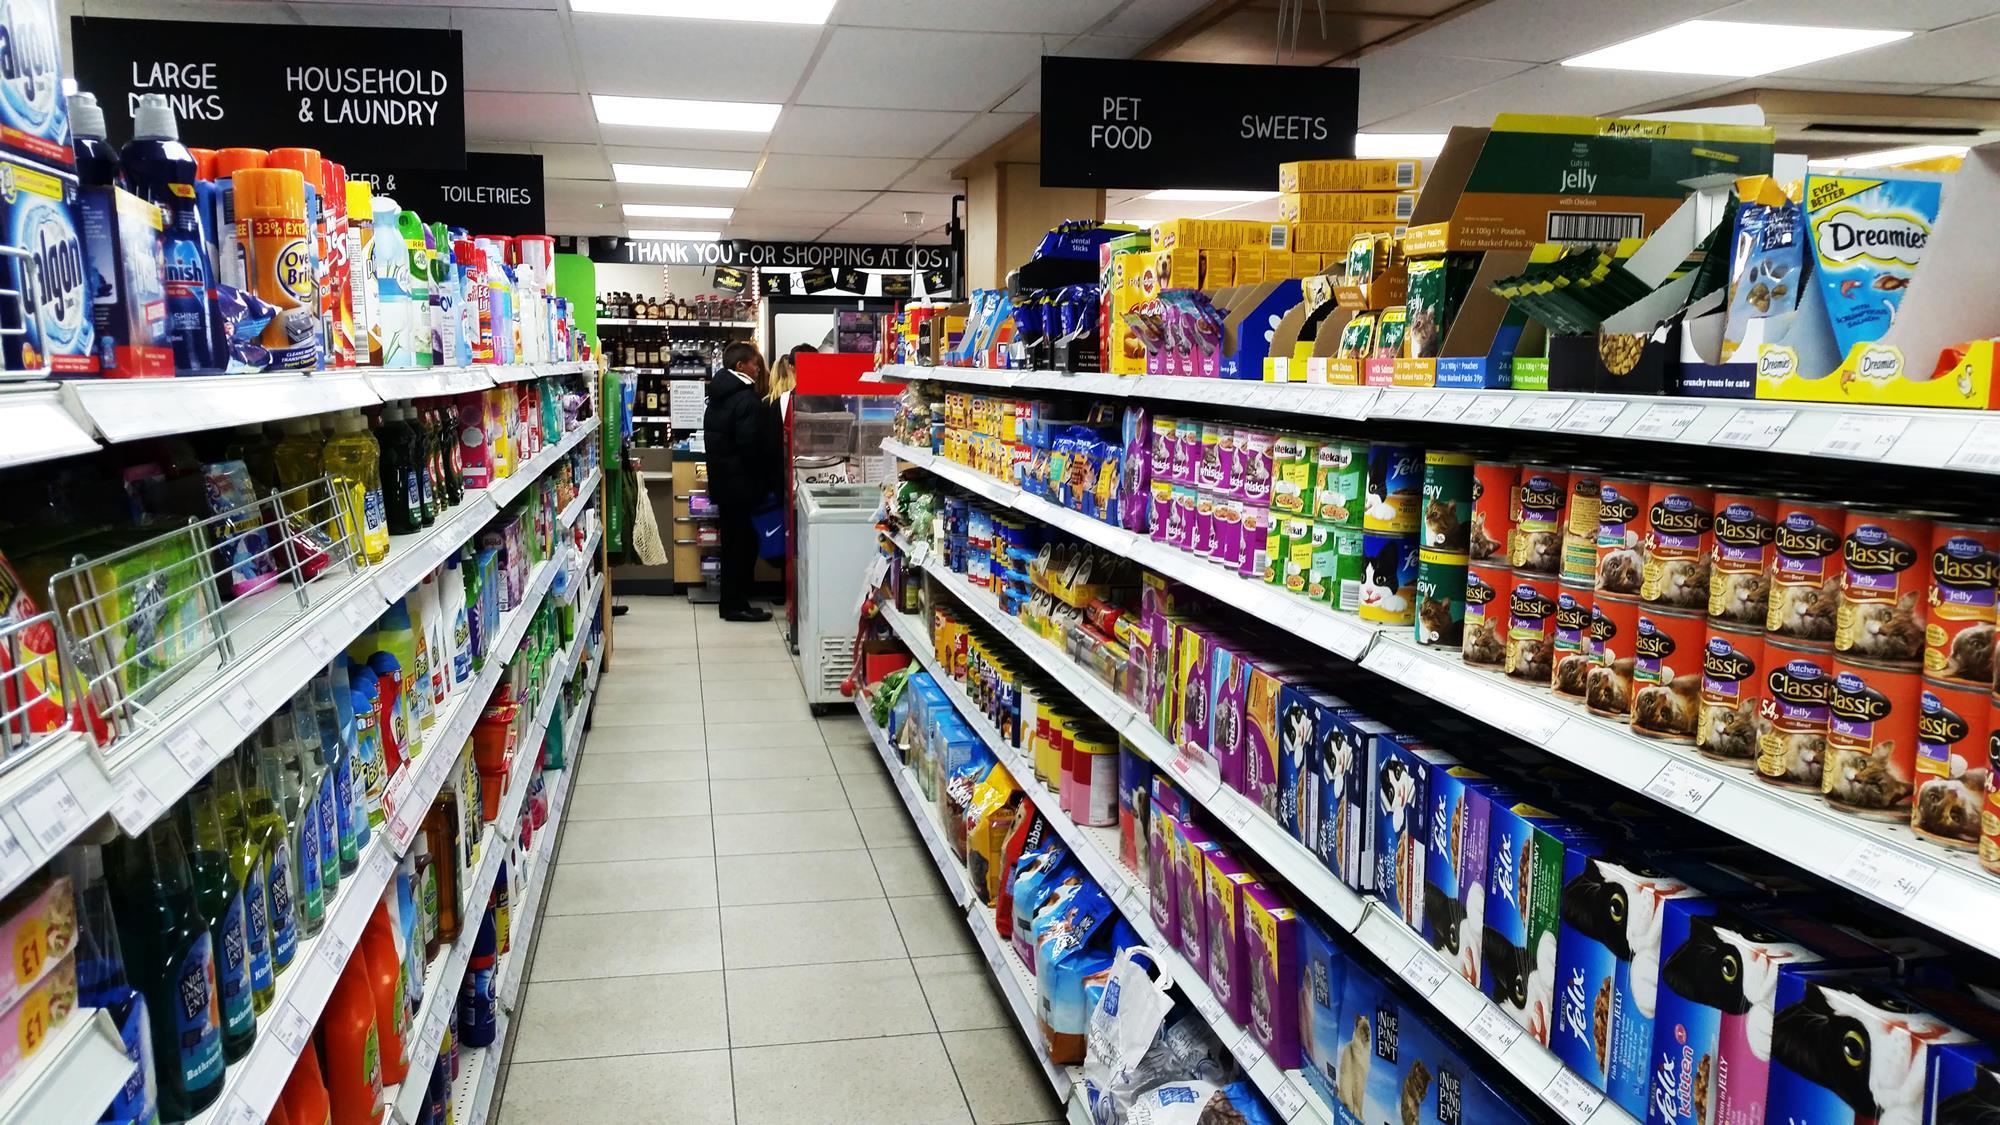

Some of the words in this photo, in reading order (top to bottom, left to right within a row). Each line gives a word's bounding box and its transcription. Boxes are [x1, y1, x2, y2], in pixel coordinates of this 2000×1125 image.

[132, 61, 218, 89] LARGE
[286, 66, 448, 96] HOUSEHOLD
[128, 92, 224, 120] DNKS
[298, 97, 314, 122] &
[324, 98, 439, 126] LAUNDRY
[1102, 96, 1141, 121] PET
[1090, 124, 1153, 150] FOOD
[1240, 115, 1328, 141] SWEETS
[1607, 121, 1631, 135] Any
[1570, 159, 1582, 168] Cuts
[386, 174, 396, 191] &
[1560, 169, 1598, 193] Jelly
[1812, 181, 1839, 198] EVEN
[441, 185, 532, 205] TOILETRIES
[1559, 198, 1573, 206] with
[1574, 199, 1597, 207] Chicken
[1811, 188, 1846, 210] BETTER
[256, 222, 282, 235] 33%
[1500, 227, 1526, 236] Pouches
[1828, 222, 1928, 252] Dreamies
[1460, 239, 1476, 247] Price
[1478, 239, 1503, 248] Marked
[1505, 240, 1523, 248] Packs
[285, 252, 310, 267] Ove
[625, 241, 688, 264] THANK
[693, 241, 733, 264] YOU
[783, 246, 874, 267] SHOPPING
[880, 248, 901, 267] AT
[166, 257, 202, 282] nish
[1461, 362, 1478, 370] Pouches
[1762, 353, 1791, 372] Dreamies
[1863, 353, 1896, 372] Dreamies
[1707, 378, 1724, 389] treats
[1725, 378, 1735, 388] for
[1736, 378, 1750, 388] cats
[1520, 487, 1566, 506] Classic
[1663, 496, 1692, 509] Butcher's
[1600, 502, 1633, 519] assic
[1650, 506, 1710, 531] Classic
[1726, 506, 1755, 519] Butcher's
[1786, 514, 1815, 527] Butcher's
[1714, 517, 1774, 541] Classic
[1775, 526, 1833, 551] Classic
[1856, 527, 1888, 540] Butcher's
[1664, 535, 1683, 546] Jelly
[1948, 541, 1984, 553] Butcher's
[1727, 548, 1745, 560] Jelly
[1843, 539, 1909, 566] Classic
[1786, 559, 1804, 570] Jelly
[1933, 552, 2000, 581] Classic
[1857, 574, 1877, 587] Jelly
[1466, 586, 1491, 600] assic
[1950, 590, 1972, 604] Jelly
[1510, 595, 1551, 615] Classic
[1557, 606, 1590, 627] lassic
[1636, 635, 1669, 655] assic
[1788, 663, 1822, 675] Butcher's
[1769, 672, 1831, 699] Classi
[1836, 677, 1864, 690] Butcher's
[1788, 705, 1811, 718] Jelly
[1836, 721, 1854, 733] Jelly
[1919, 714, 1960, 739] assic
[1434, 794, 1450, 865] felix
[1498, 833, 1516, 910] felix
[1226, 887, 1233, 903] £1
[1267, 924, 1275, 943] £1
[22, 940, 39, 976] £1
[188, 993, 207, 1019] ENT
[1567, 967, 1591, 1052] felix
[1615, 989, 1624, 1019] JELLY
[26, 1012, 42, 1049] £1
[1378, 1010, 1398, 1032] INDE
[1378, 1028, 1398, 1047] PEND
[1612, 1030, 1620, 1062] Selection
[1378, 1041, 1397, 1061] ENT
[1440, 1070, 1460, 1096] INDE
[1678, 1044, 1694, 1118] kitten
[1719, 1056, 1729, 1090] JELLY
[1656, 1052, 1676, 1125] felix
[1440, 1089, 1460, 1112] PEND
[1577, 1100, 1594, 1115] 4.39
[1440, 1105, 1460, 1125] ENT
[1717, 1102, 1726, 1125] ction
